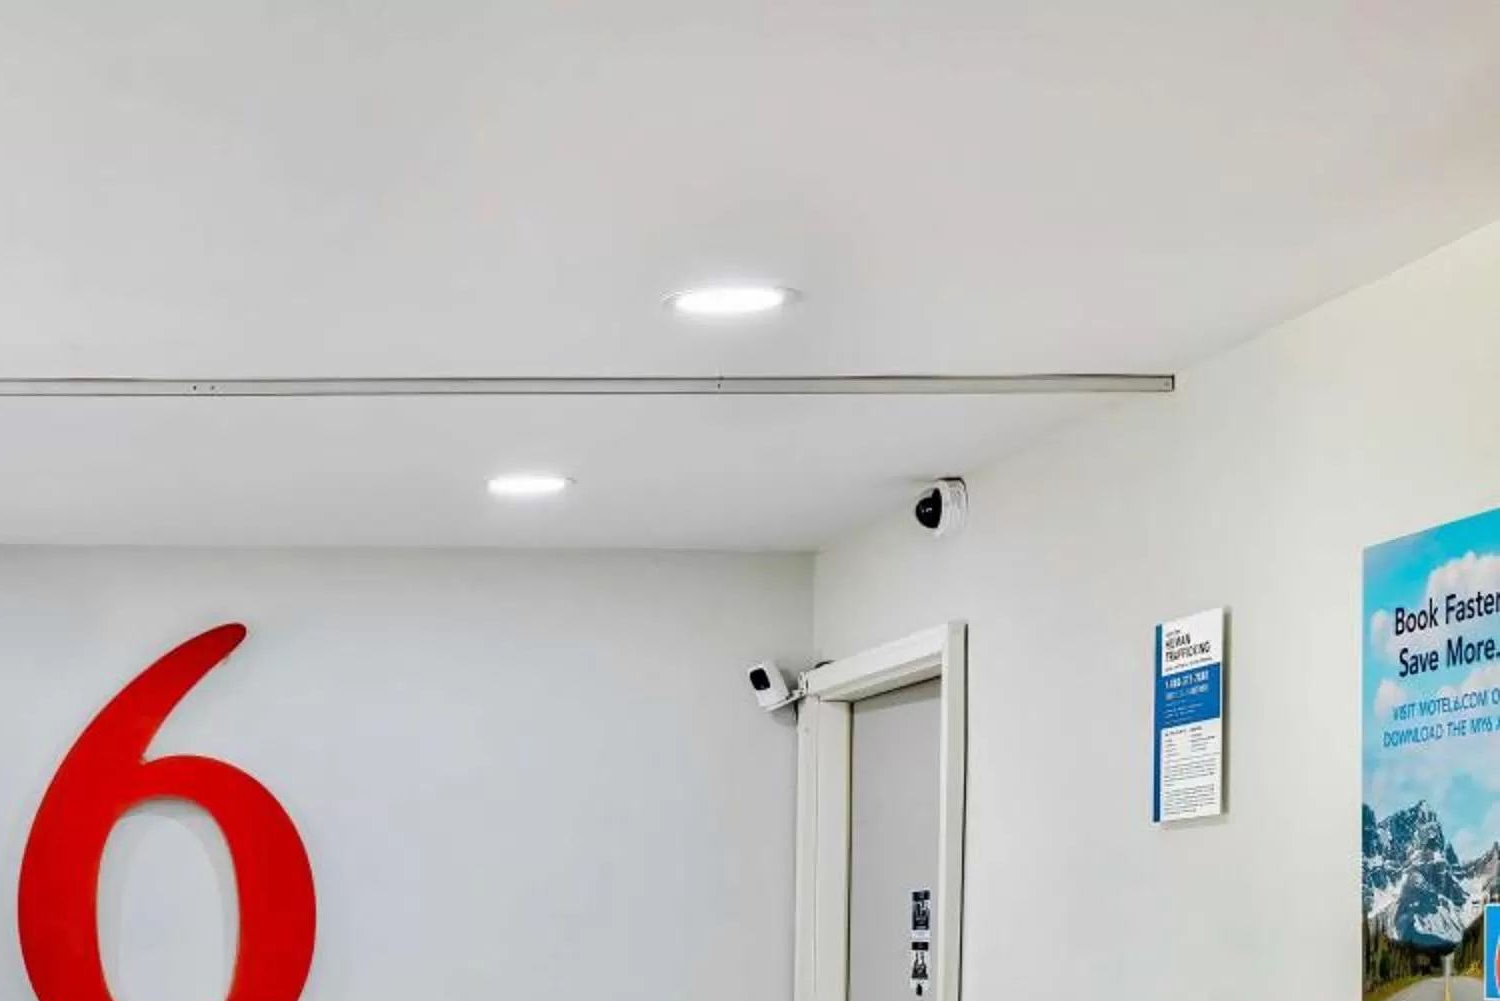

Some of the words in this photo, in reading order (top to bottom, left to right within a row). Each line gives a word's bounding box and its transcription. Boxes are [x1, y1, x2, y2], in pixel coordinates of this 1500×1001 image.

[1395, 597, 1439, 636] Book
[1165, 639, 1212, 663] TRAFFICKING
[1399, 647, 1439, 677] Save
[1446, 635, 1500, 668] More.
[1393, 702, 1416, 720] VISIT
[1383, 723, 1444, 749] DOWNLOAD
[1447, 719, 1467, 738] THE
